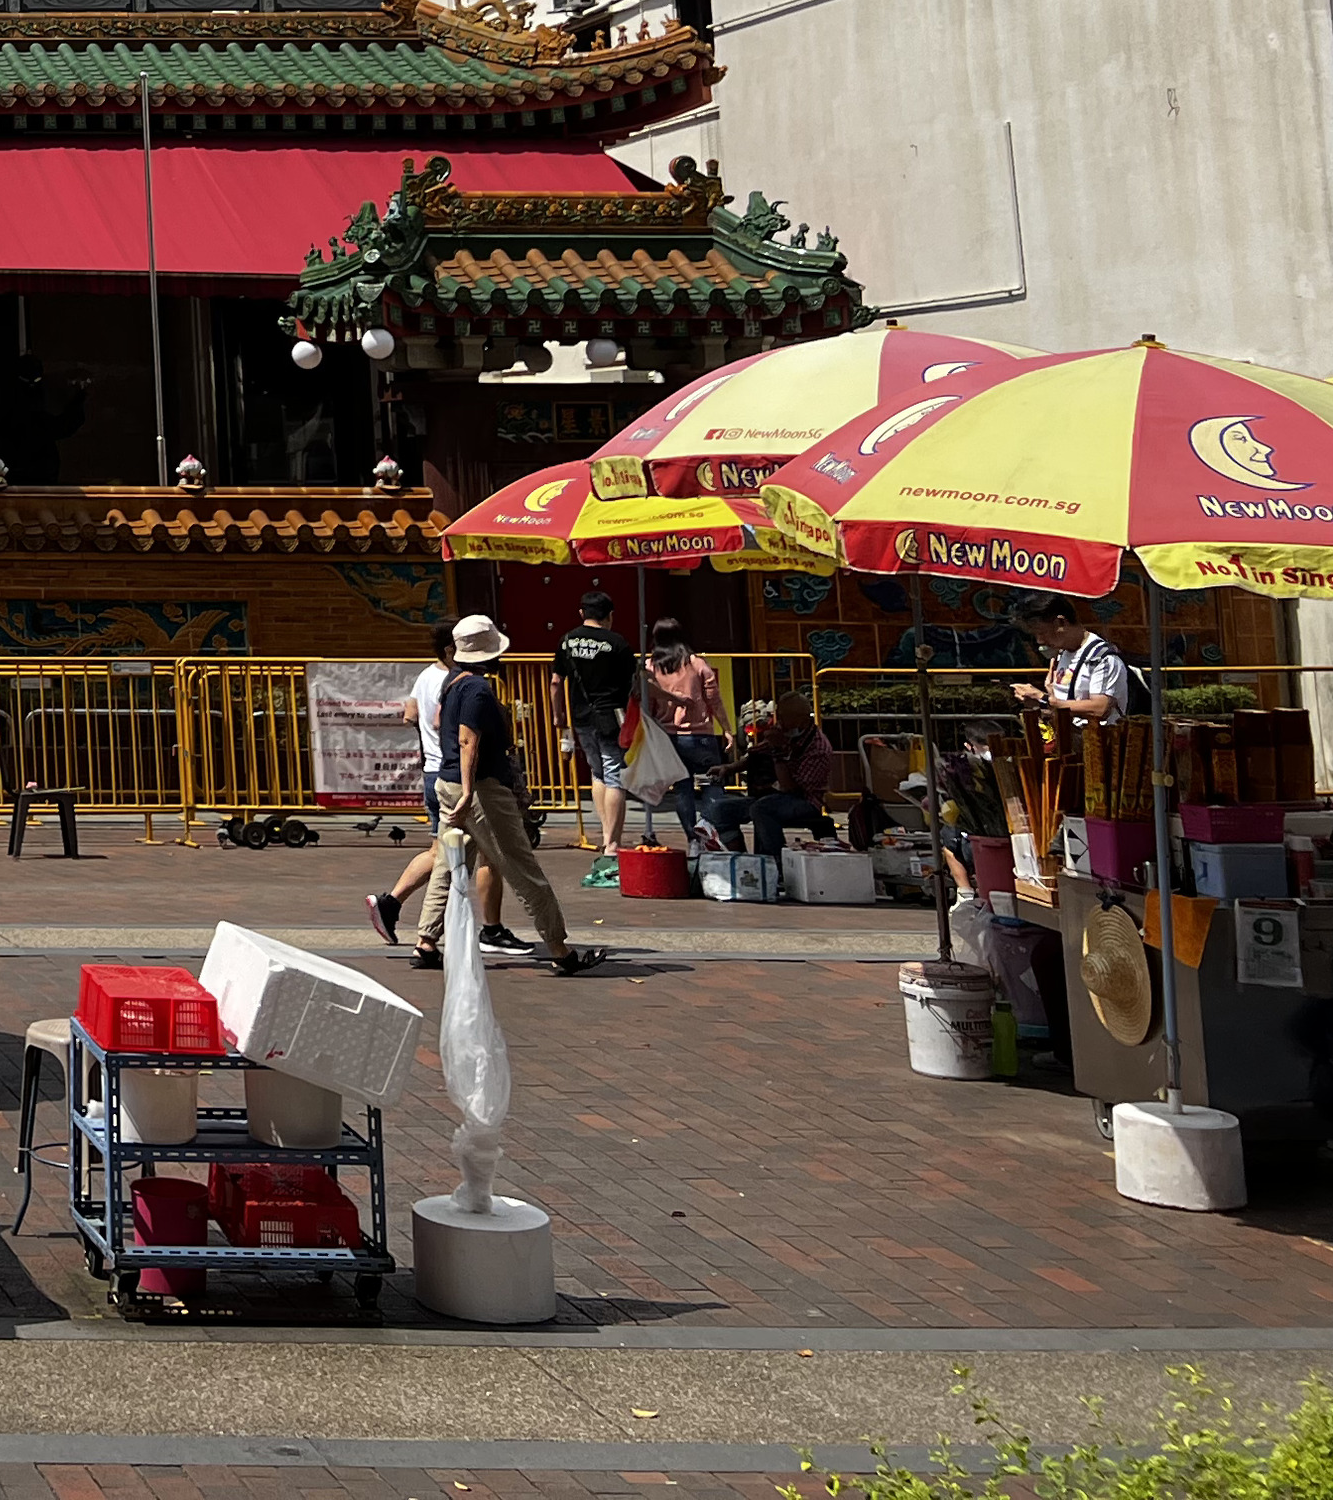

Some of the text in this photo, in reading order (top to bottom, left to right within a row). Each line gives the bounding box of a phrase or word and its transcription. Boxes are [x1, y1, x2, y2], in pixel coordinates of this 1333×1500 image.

[744, 428, 824, 440] NewMoonSG
[898, 485, 1082, 515] newmoon.com.sg
[1250, 566, 1276, 586] in
[1253, 917, 1283, 947] 9
